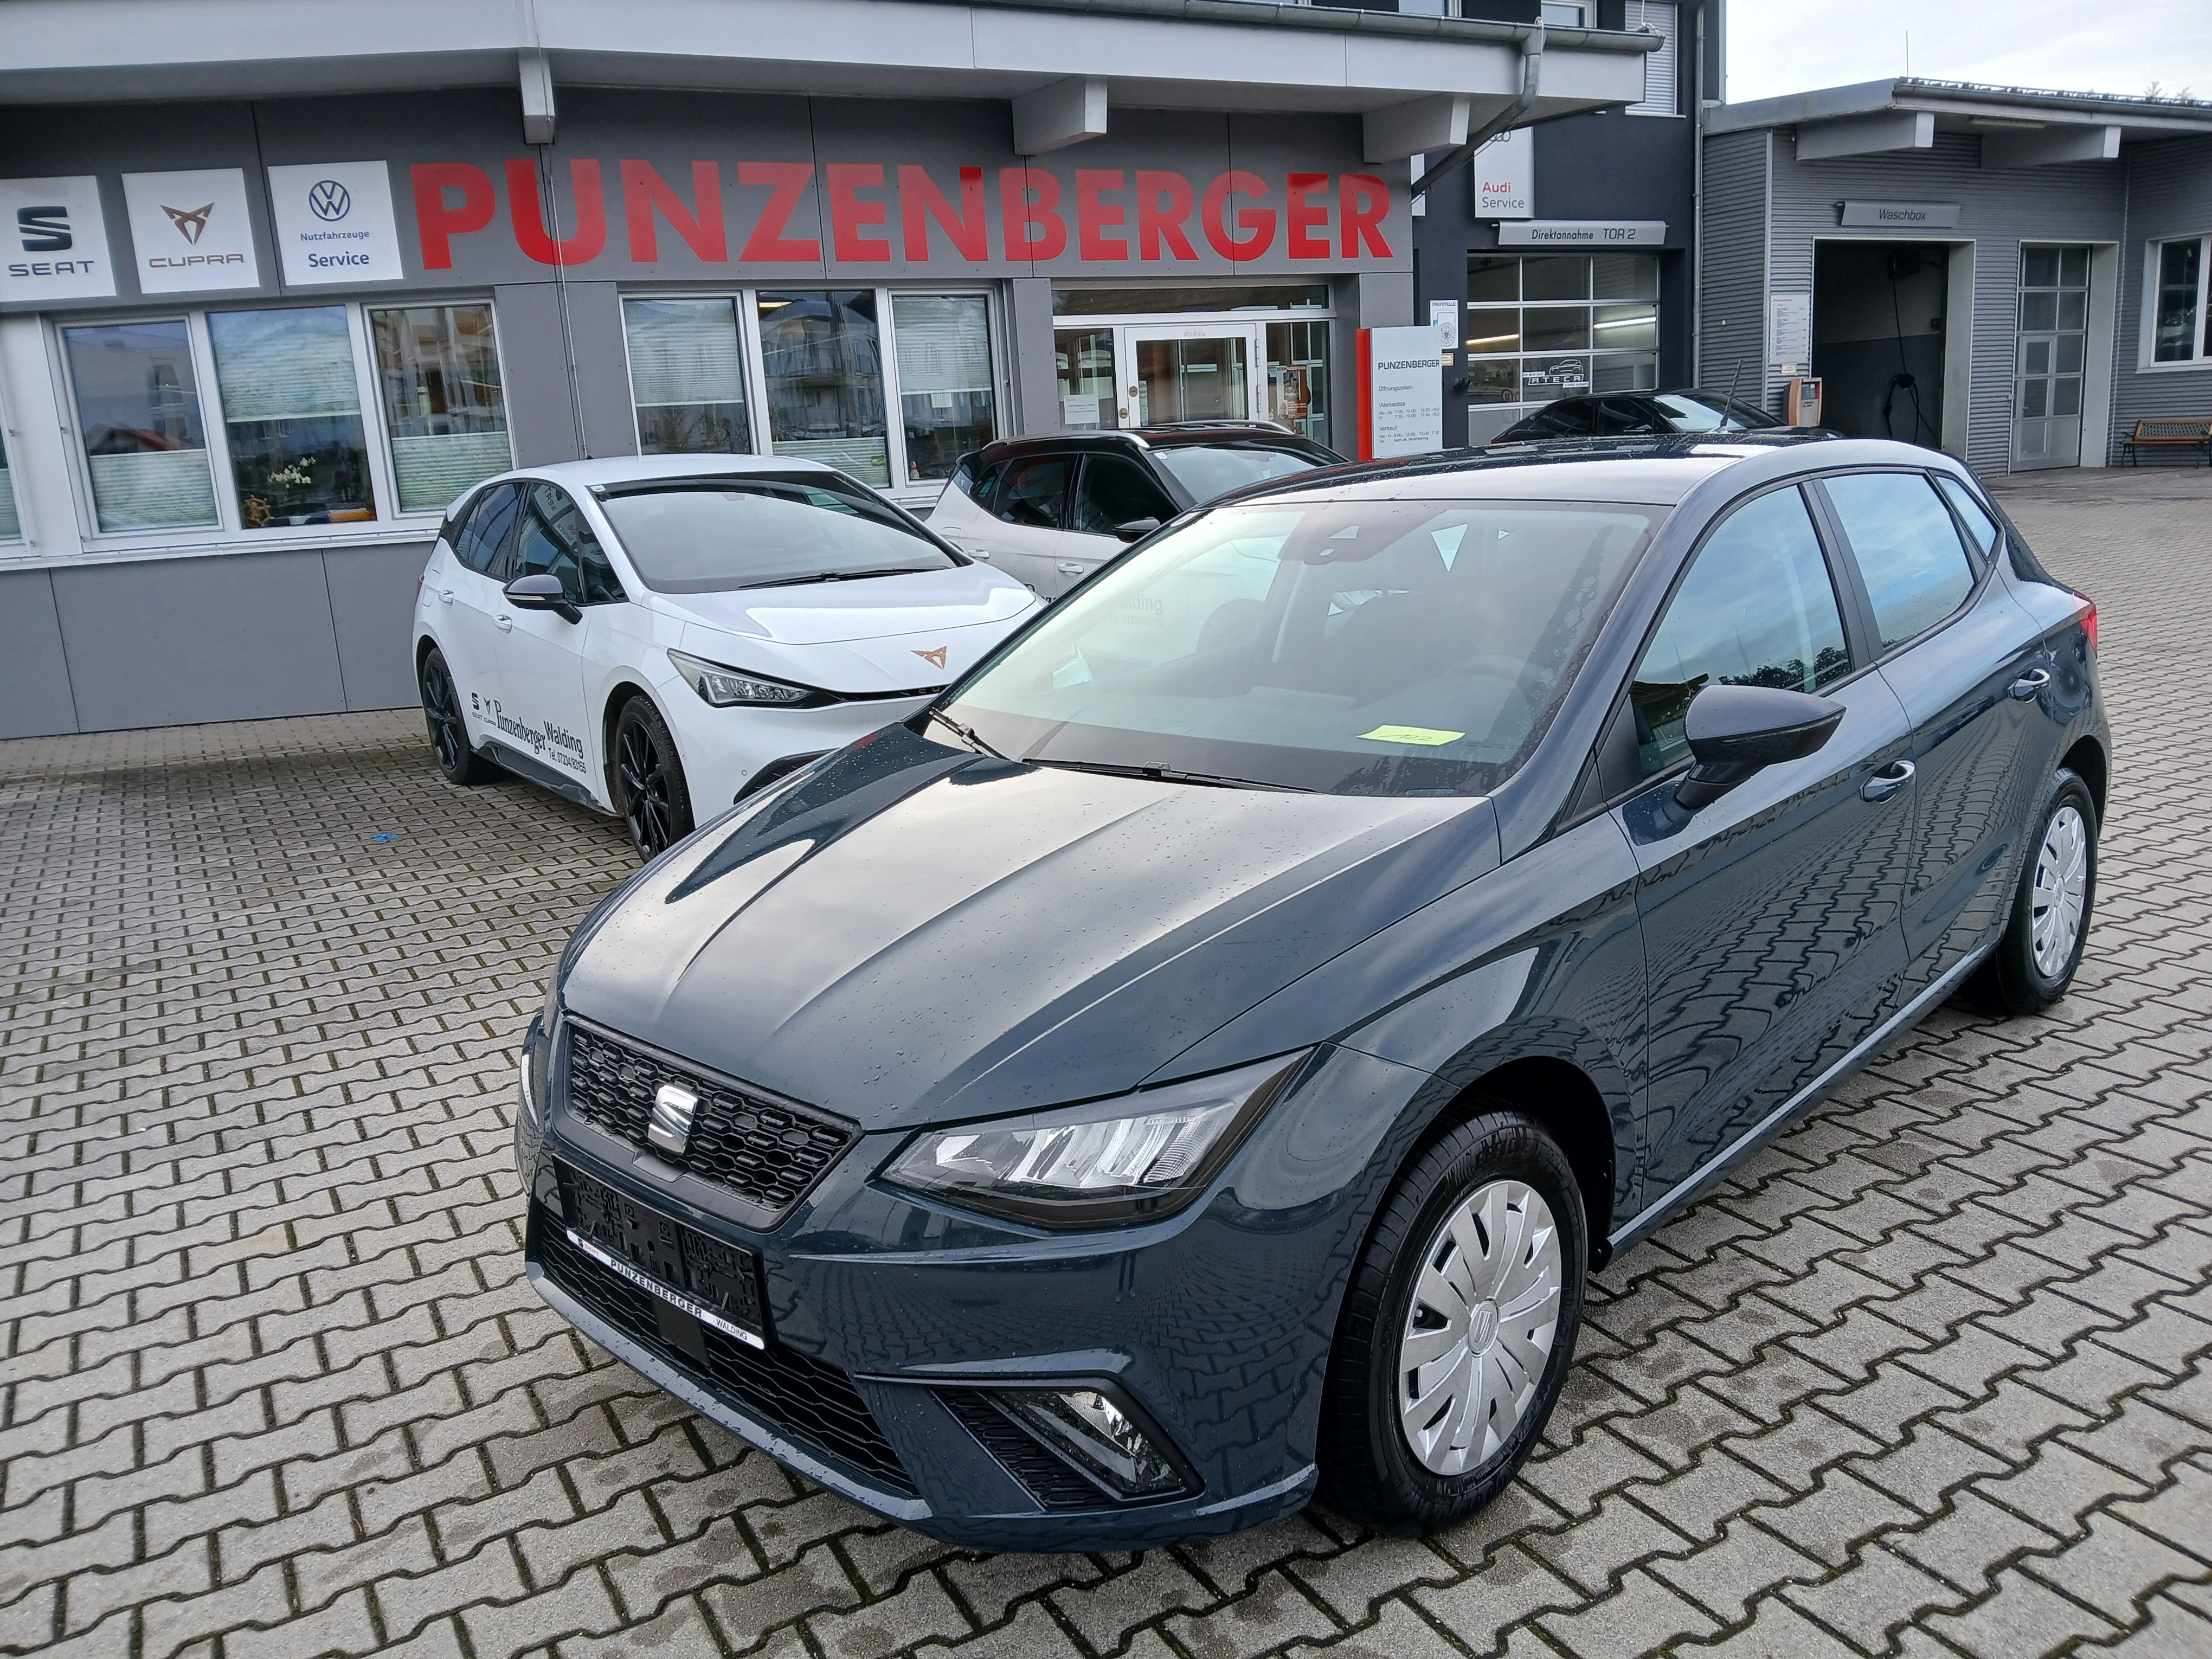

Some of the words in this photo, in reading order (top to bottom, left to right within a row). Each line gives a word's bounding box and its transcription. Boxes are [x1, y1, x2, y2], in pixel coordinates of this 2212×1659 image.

[1482, 181, 1511, 193] Audi
[1482, 197, 1525, 208] Service
[410, 158, 1394, 270] PUNZENBERGER
[1879, 209, 1927, 222] Waschbox
[300, 230, 370, 242] Nutzfahrzeuge
[1531, 229, 1594, 240] Direktannahme
[1603, 228, 1625, 240] TOR
[1628, 228, 1636, 240] 2
[149, 253, 245, 268] CUPRA
[307, 250, 369, 268] Service
[7, 260, 94, 277] SEAT
[1378, 359, 1440, 370] PUNZENBERGER
[1532, 375, 1581, 383] ATECA
[493, 699, 545, 754] Punzenberger
[543, 720, 583, 759] Walding
[548, 747, 557, 762] Tel.
[610, 1258, 702, 1318] PUNZENBERGER
[716, 1318, 748, 1340] WALDING
